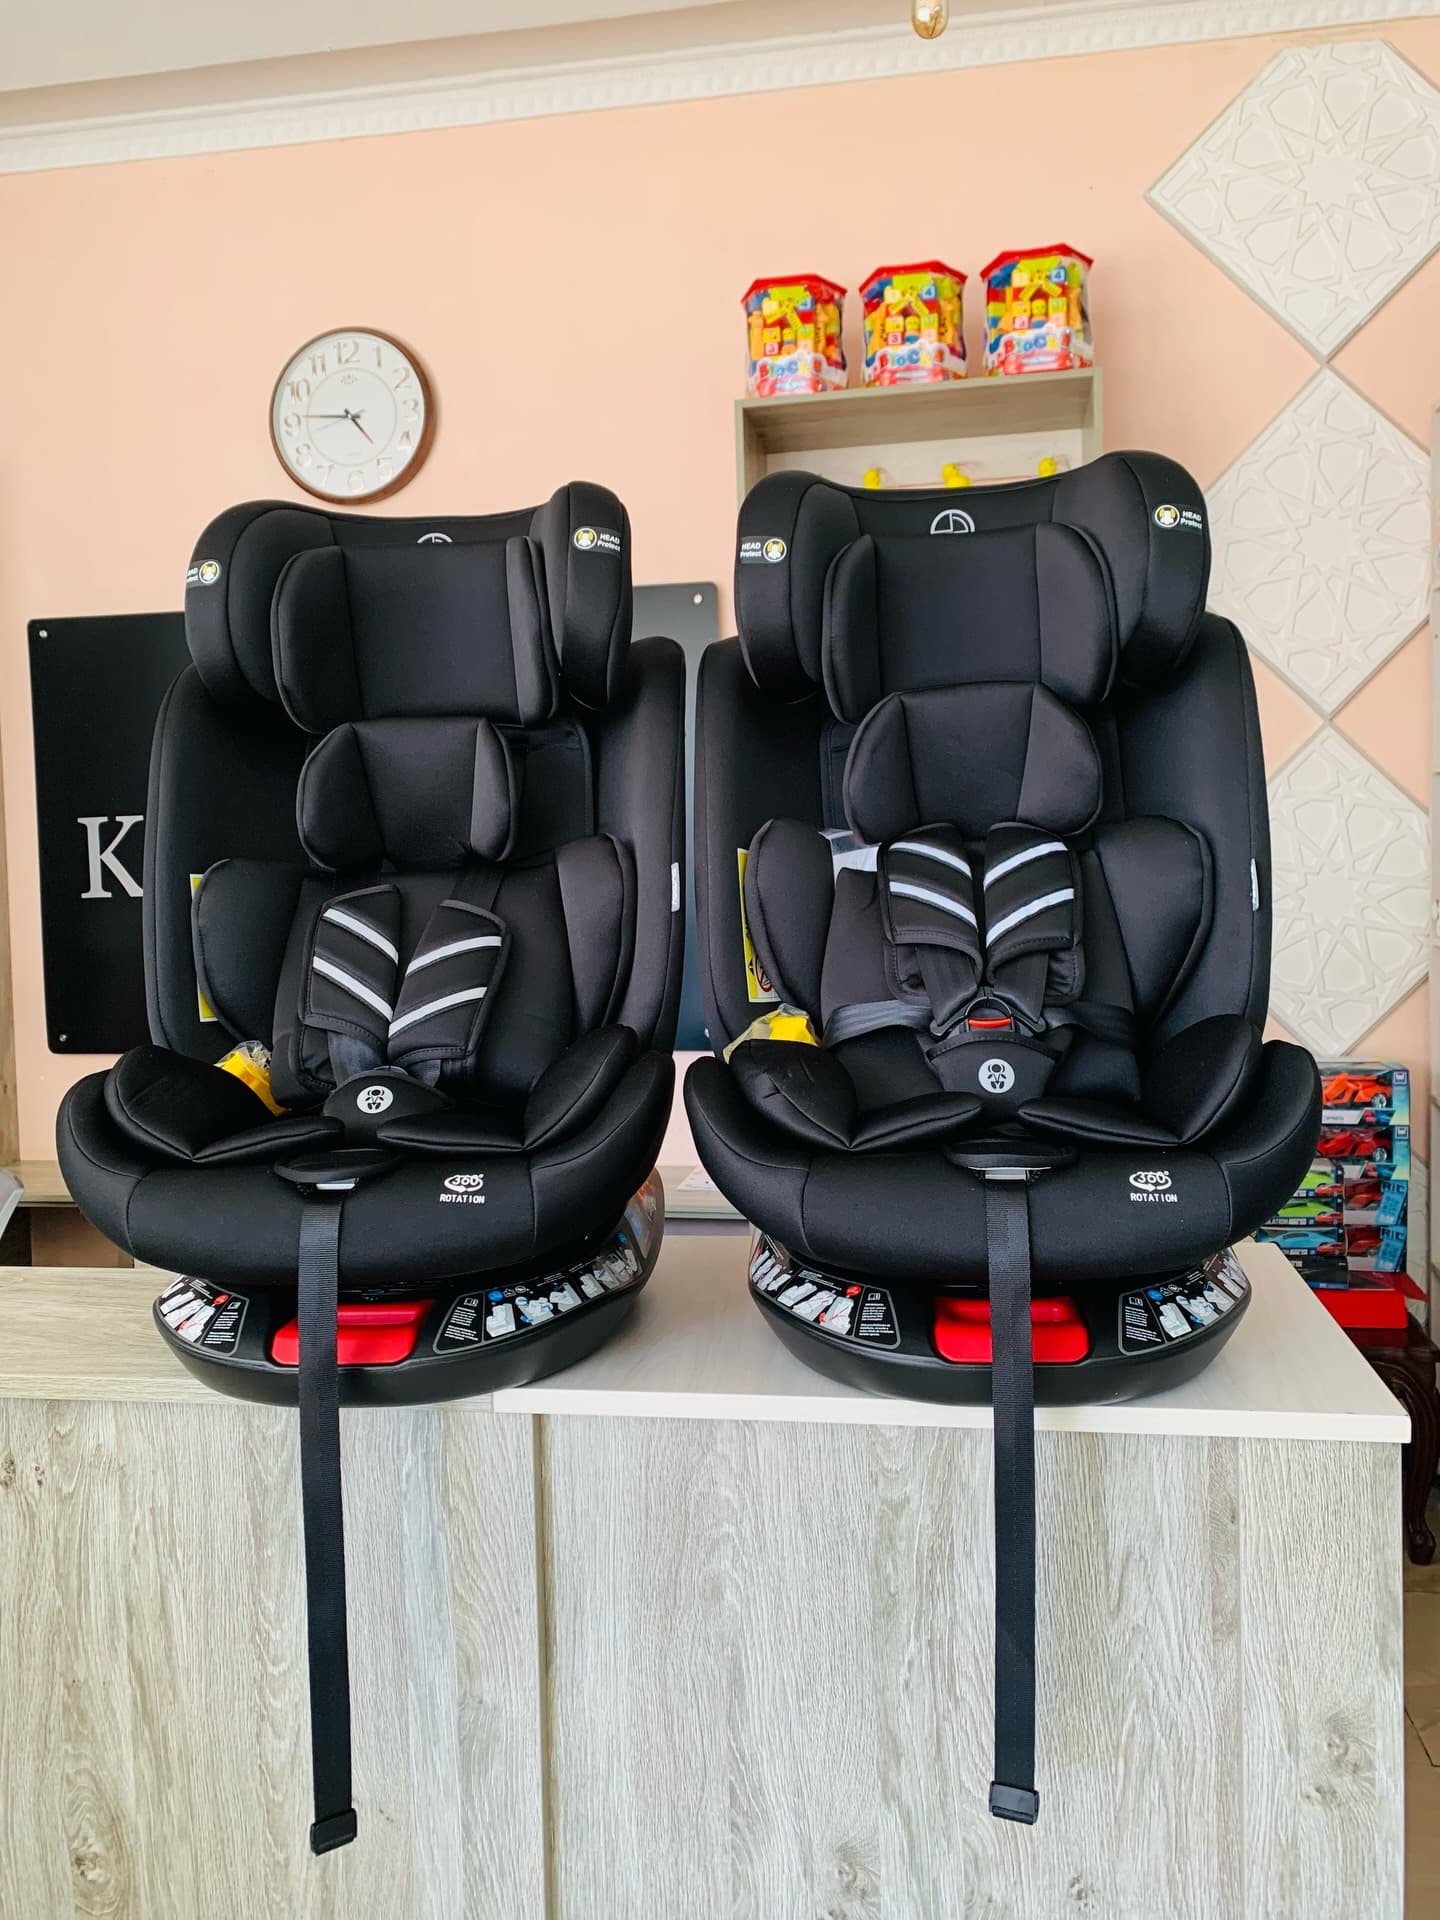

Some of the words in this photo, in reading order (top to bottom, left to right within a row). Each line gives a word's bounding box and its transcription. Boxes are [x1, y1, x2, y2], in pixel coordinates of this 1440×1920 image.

[891, 333, 899, 345] 3
[308, 353, 326, 376] 11
[334, 341, 360, 365] 12
[374, 345, 382, 368] 1
[288, 379, 310, 402] 10
[393, 367, 411, 391] 2
[403, 399, 419, 422] 3
[284, 412, 301, 437] 9
[296, 443, 312, 467] 8
[316, 464, 334, 488] 7
[376, 457, 393, 480] 5
[348, 470, 364, 492] 6
[1182, 510, 1202, 521] HEAD
[600, 533, 620, 544] HEAD
[741, 542, 761, 551] HEAD
[77, 815, 144, 898] K
[440, 1193, 486, 1204] ROTATION
[1130, 1192, 1178, 1203] ROTATION
